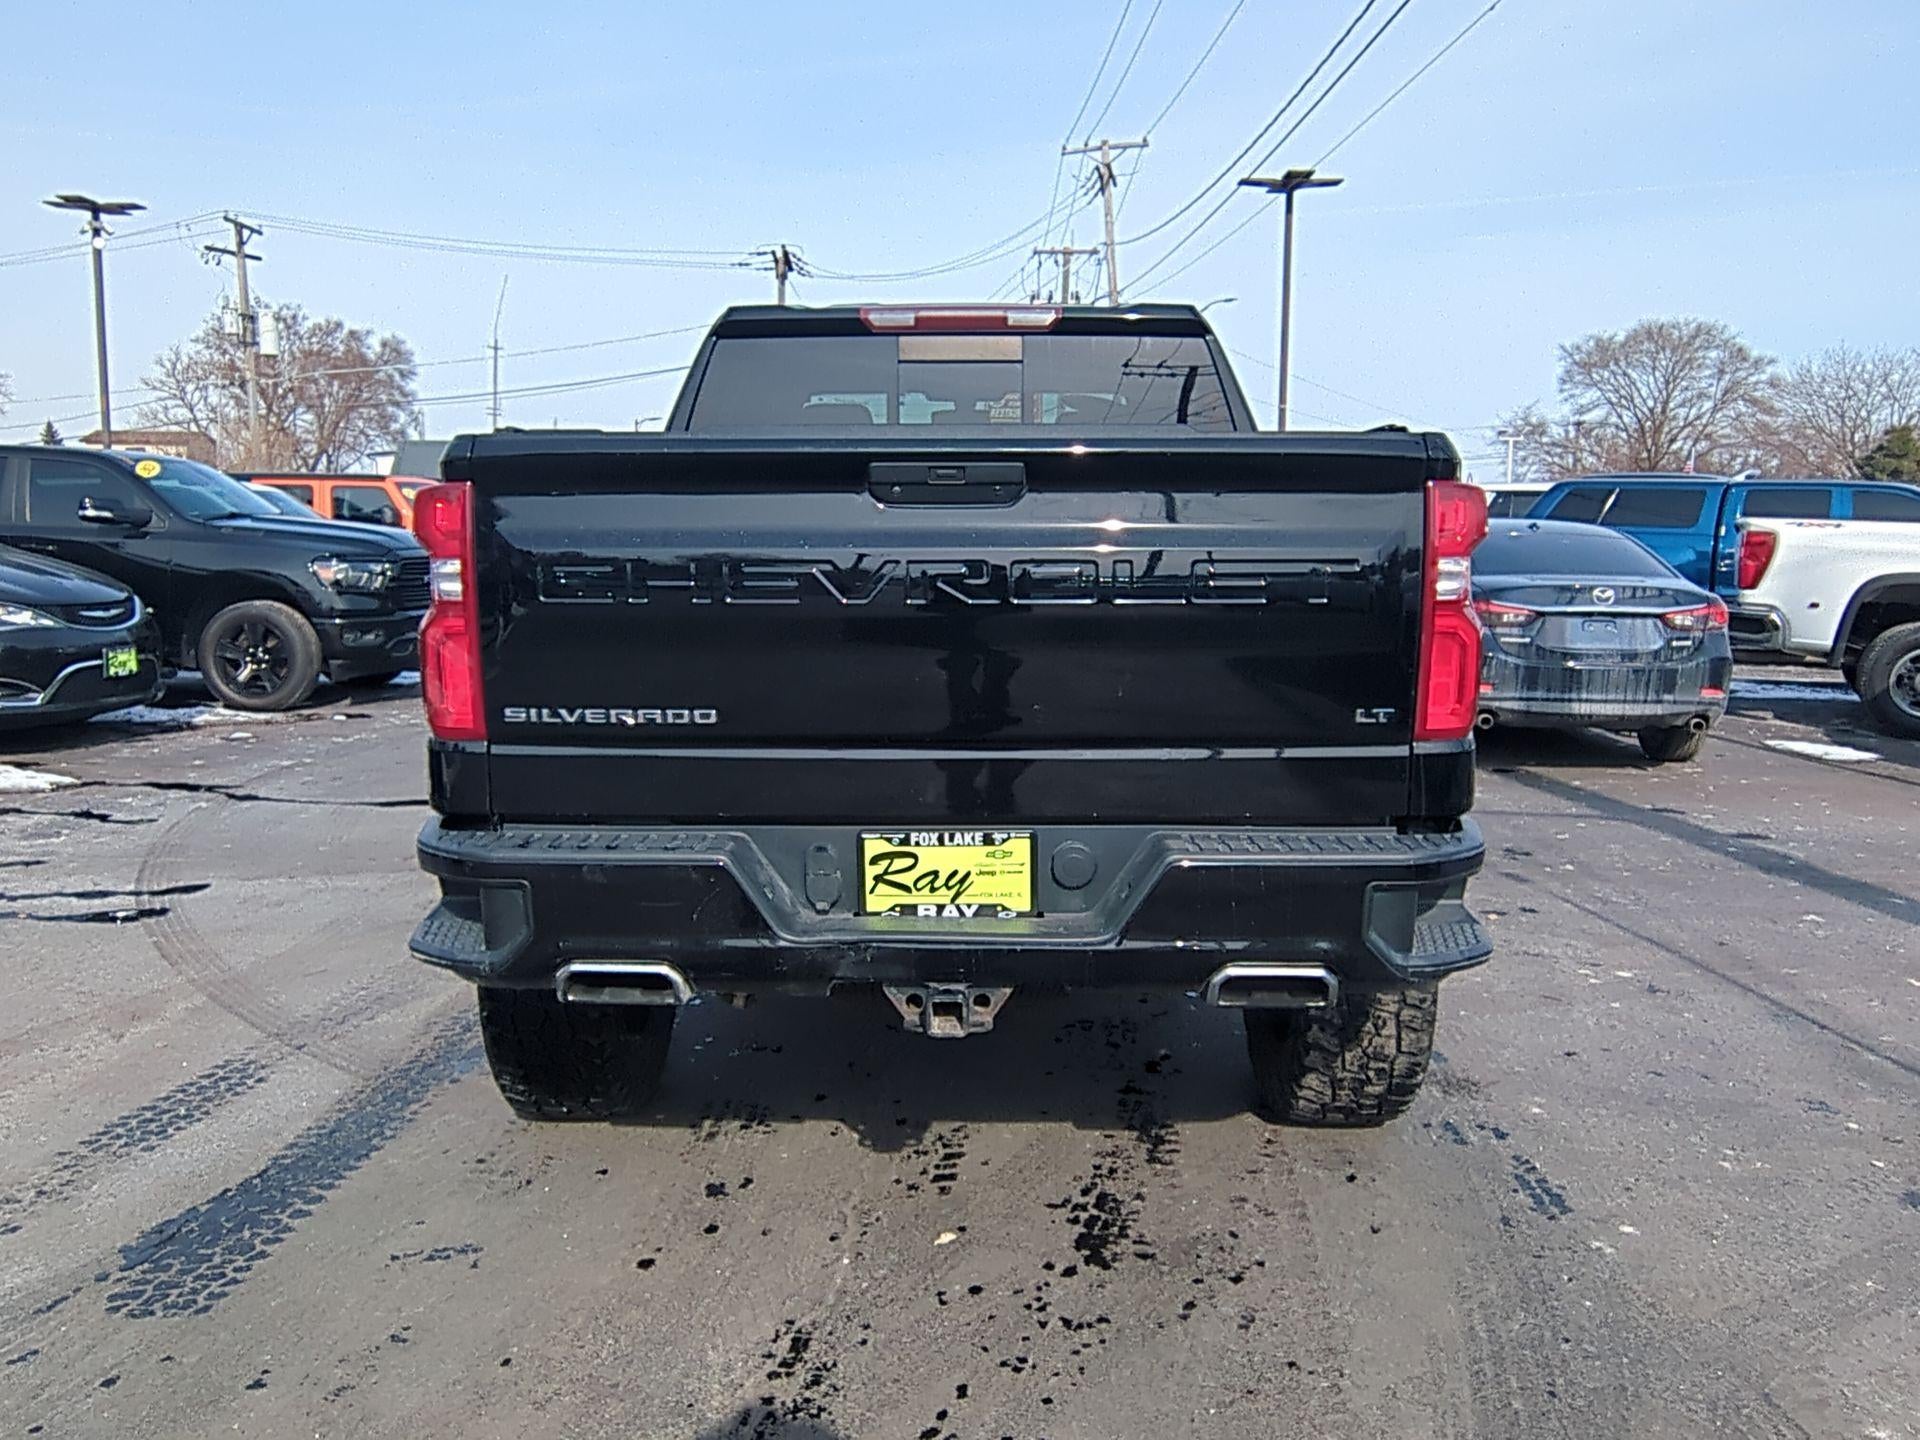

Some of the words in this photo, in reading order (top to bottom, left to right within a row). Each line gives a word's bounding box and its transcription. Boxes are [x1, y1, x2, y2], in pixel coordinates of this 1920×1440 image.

[537, 559, 1360, 604] CHEVROLET
[503, 707, 718, 725] SILVERADO
[1355, 708, 1395, 723] LT
[910, 832, 939, 846] FOX
[944, 832, 984, 846] LAKE
[869, 851, 974, 903] Ray
[976, 869, 997, 877] Jeep
[917, 904, 979, 918] RAY
